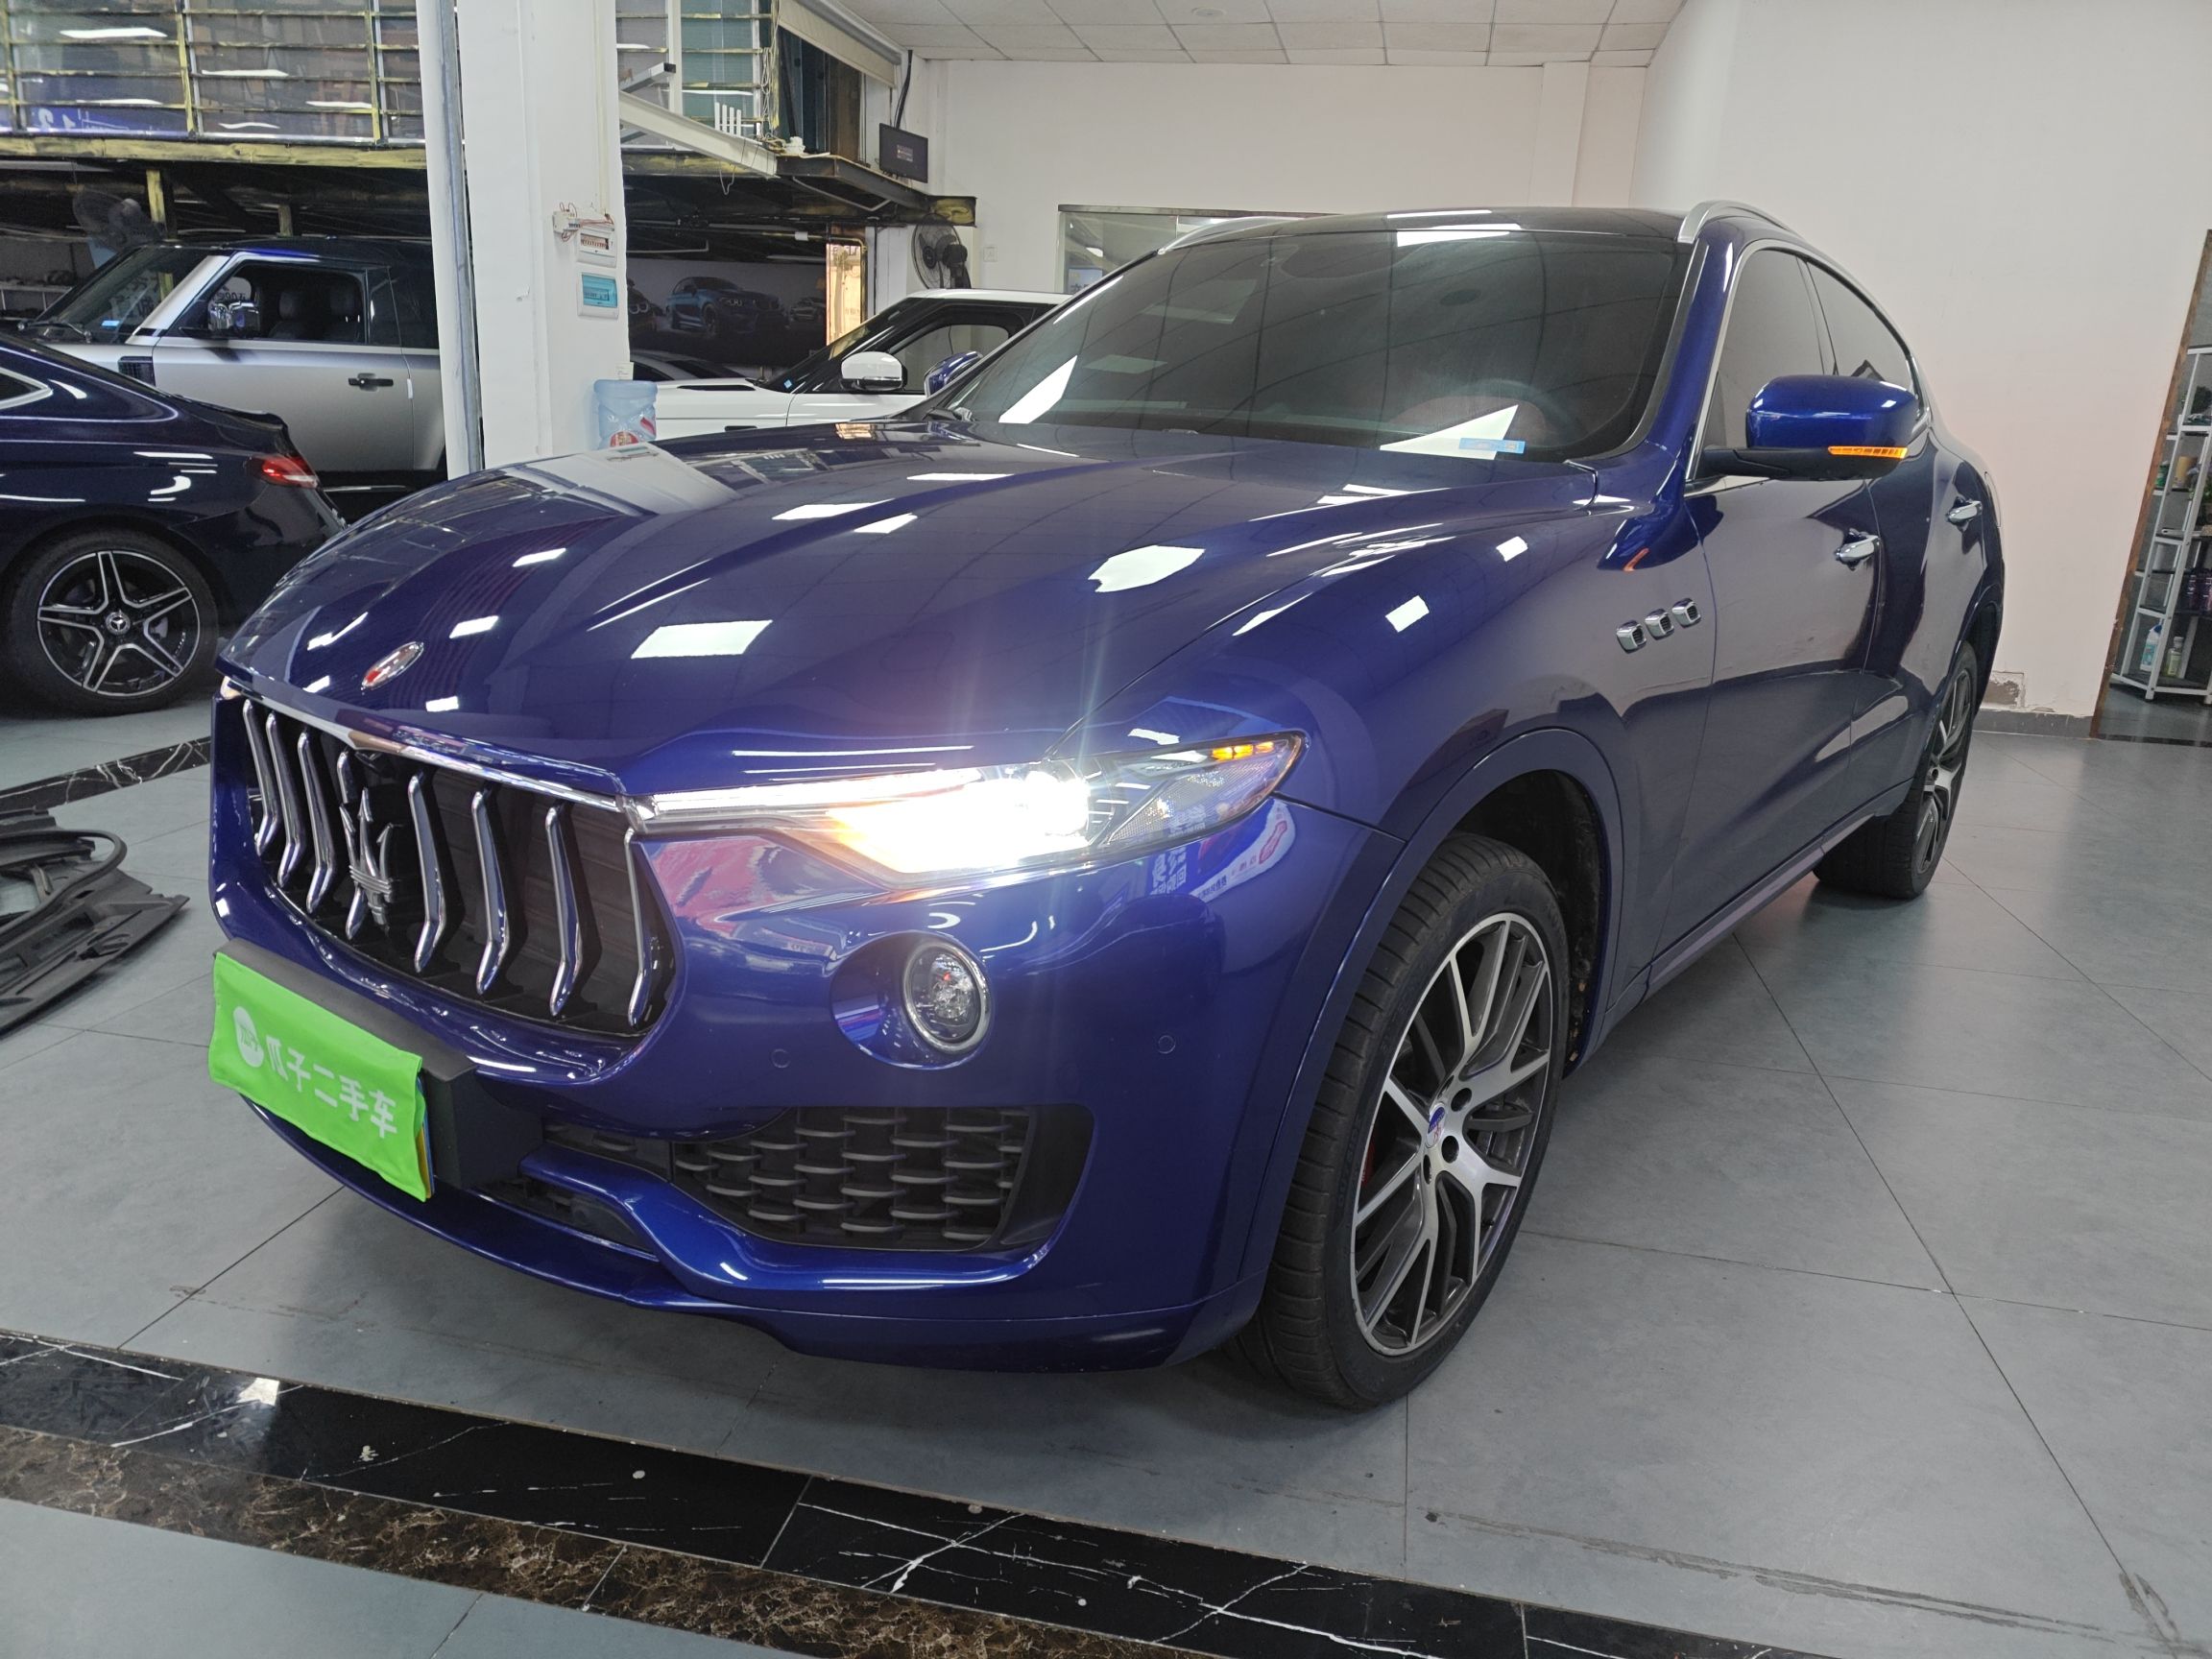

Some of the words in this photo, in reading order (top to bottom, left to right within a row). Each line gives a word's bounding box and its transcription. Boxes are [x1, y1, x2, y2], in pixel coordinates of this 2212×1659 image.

[266, 1035, 397, 1139] 瓜子二手车
